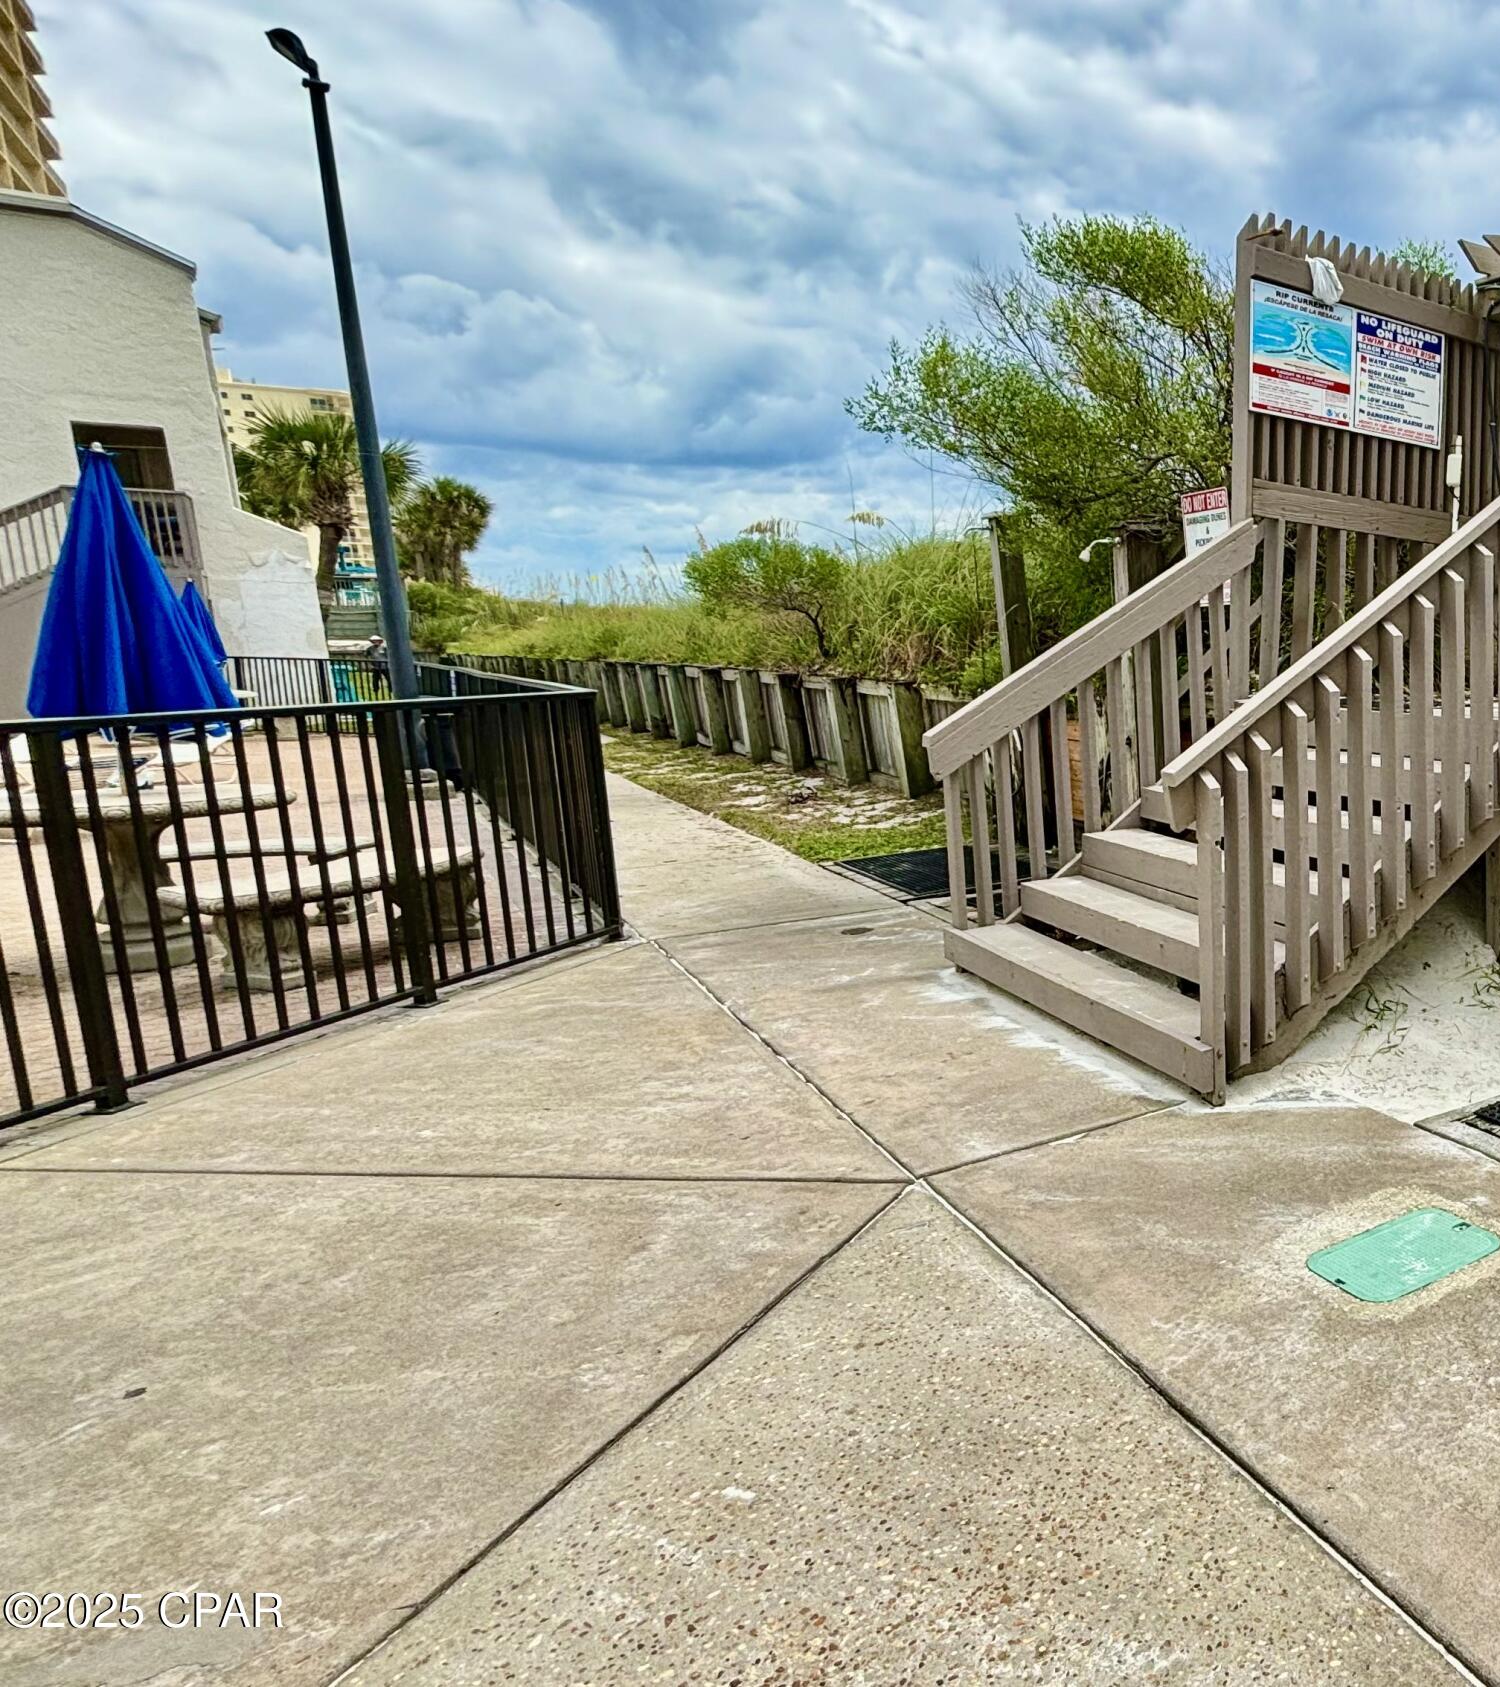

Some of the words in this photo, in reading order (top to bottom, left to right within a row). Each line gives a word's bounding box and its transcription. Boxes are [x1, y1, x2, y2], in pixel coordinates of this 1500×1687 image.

[1275, 290, 1290, 299] RIP
[1308, 307, 1317, 315] LA
[1360, 314, 1379, 327] NO
[1381, 320, 1439, 344] LIFEGUARD
[1375, 328, 1394, 340] ON
[1396, 333, 1425, 349] DUTY
[1361, 335, 1385, 347] SWIM
[1386, 341, 1397, 349] AT
[1399, 345, 1418, 356] OWN
[1420, 350, 1437, 360] RISK
[1367, 368, 1382, 378] HIGH
[1383, 372, 1407, 383] HAZARD
[1368, 357, 1388, 366] WATER
[1389, 362, 1409, 372] CLOSED
[1410, 367, 1418, 375] TO
[1418, 370, 1437, 380] PUBLIC
[1368, 381, 1391, 392] MEDIUM
[1392, 388, 1415, 398] HAZARD
[1367, 395, 1381, 403] LOW
[1382, 399, 1405, 409] HAZARD
[1366, 410, 1401, 423] DANGEROUS
[1402, 418, 1424, 428] MARINE
[1424, 423, 1435, 431] LIFE
[1183, 496, 1192, 513] DO
[1192, 494, 1205, 511] NOT
[1206, 490, 1227, 509] ENTER
